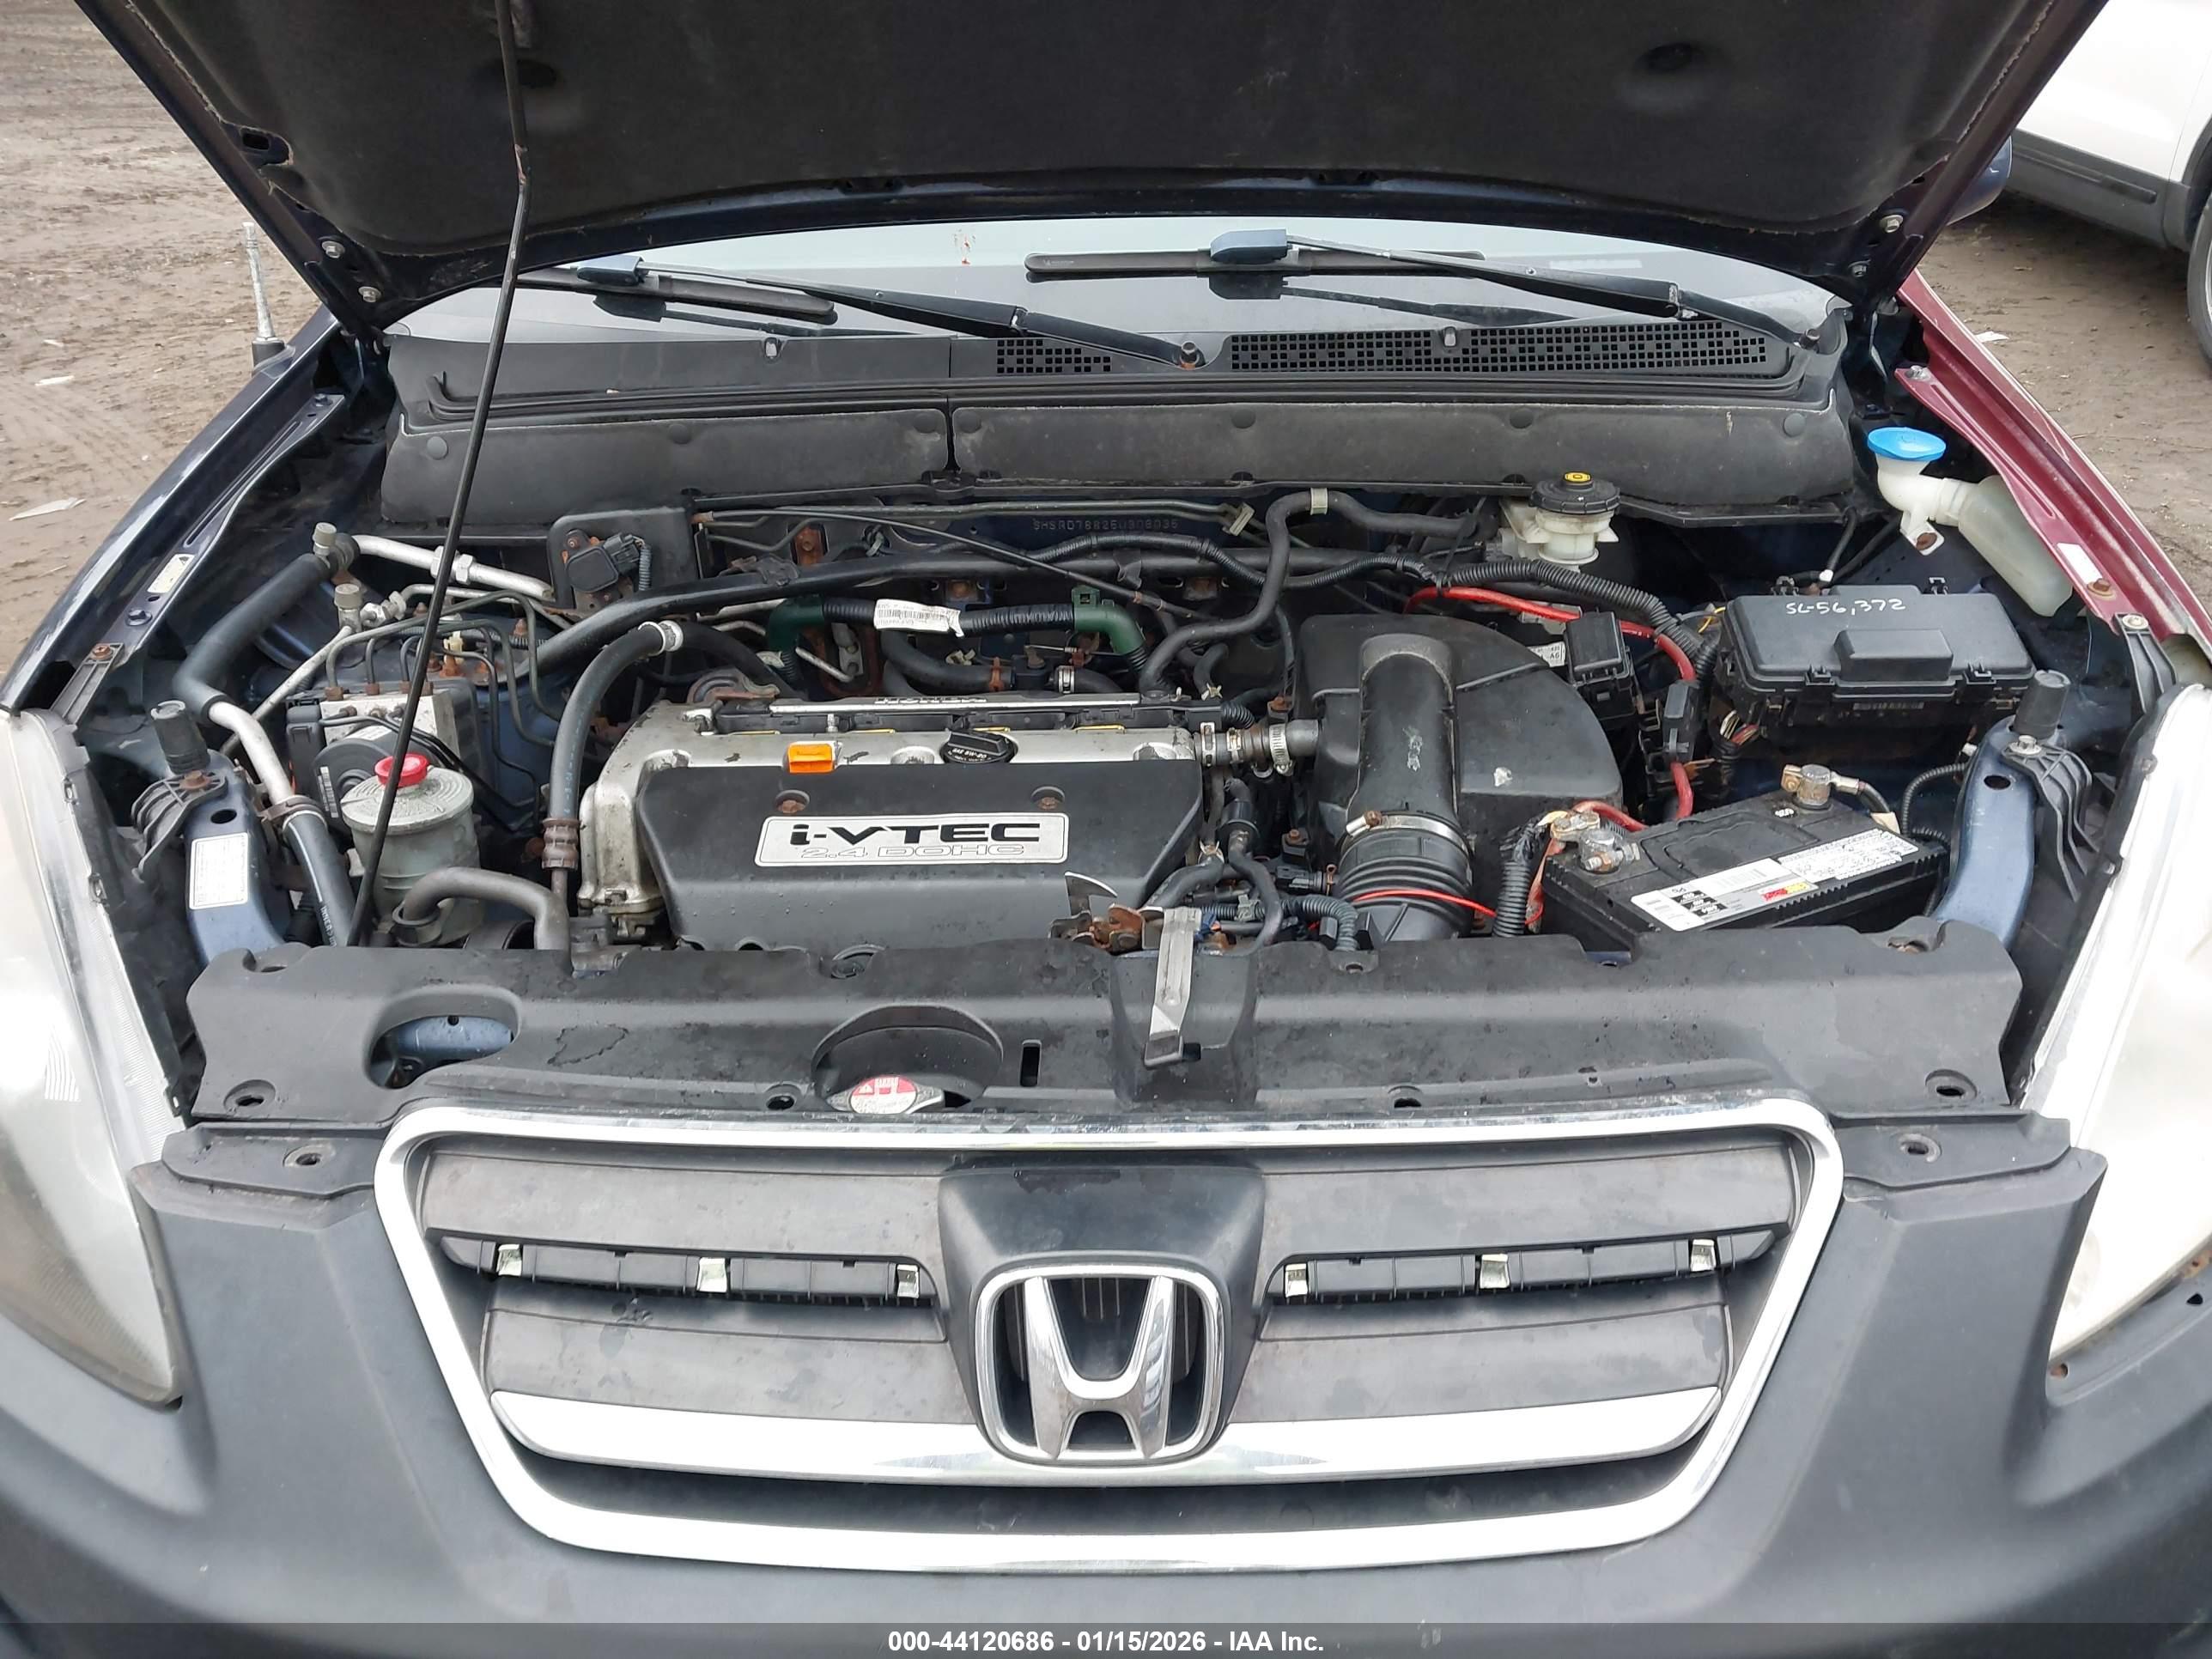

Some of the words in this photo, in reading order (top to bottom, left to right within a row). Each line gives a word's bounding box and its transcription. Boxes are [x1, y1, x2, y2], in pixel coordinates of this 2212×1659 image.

[789, 823, 1041, 846] i-VTEC
[801, 846, 868, 859] 2.4
[878, 844, 1024, 858] DOHC
